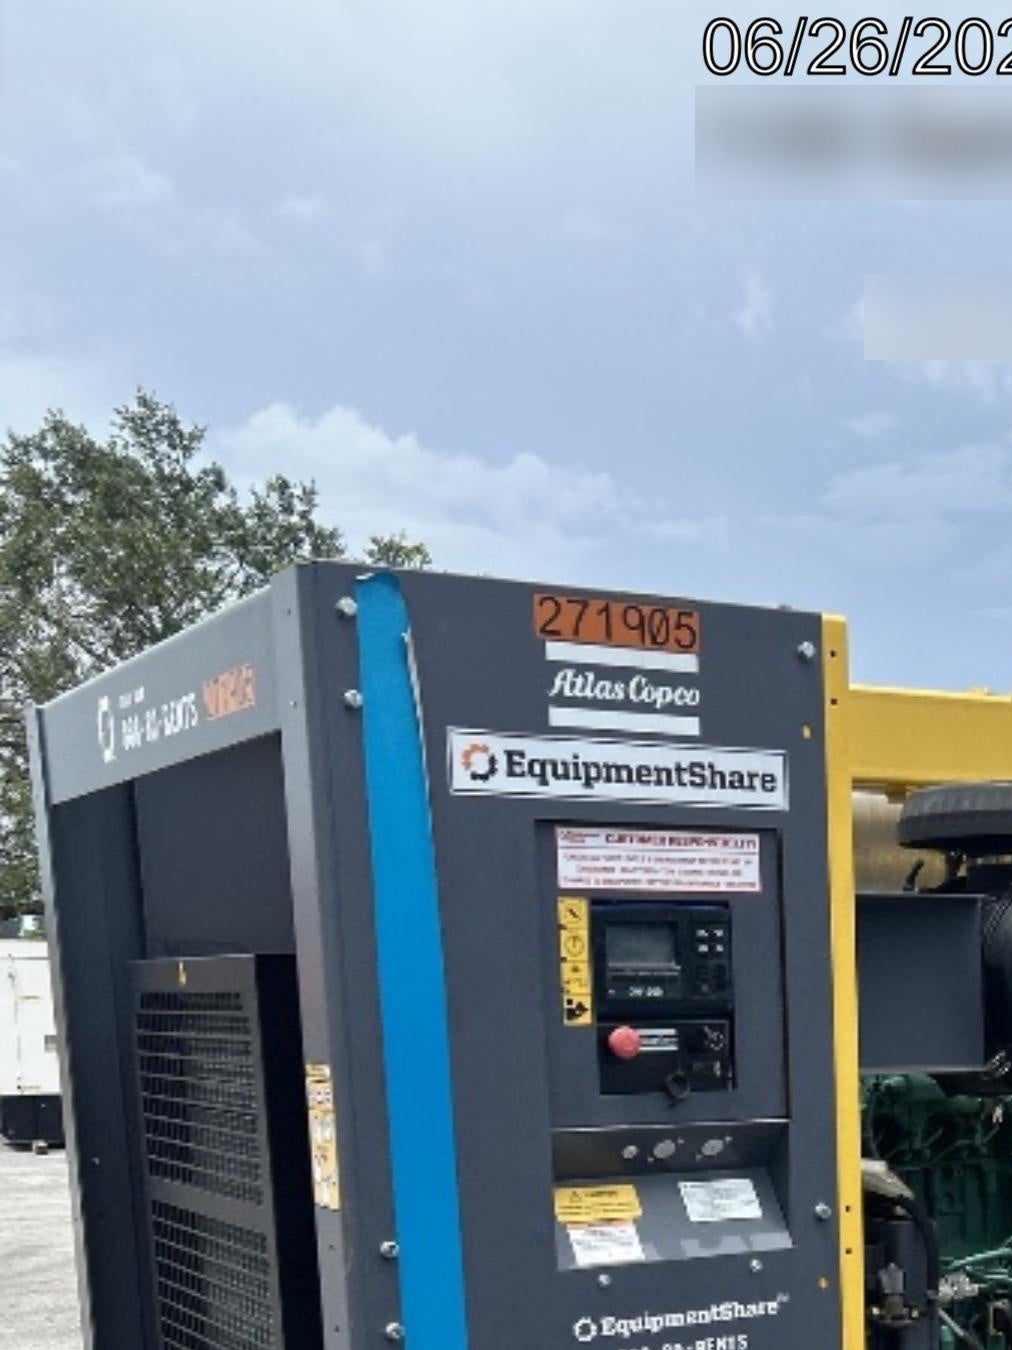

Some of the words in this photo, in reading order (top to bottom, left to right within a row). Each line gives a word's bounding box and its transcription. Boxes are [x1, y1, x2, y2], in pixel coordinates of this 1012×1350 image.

[538, 596, 697, 648] 271905
[549, 668, 624, 701] Atlas
[628, 675, 700, 708] Copco
[503, 750, 777, 792] EquipmentShare
